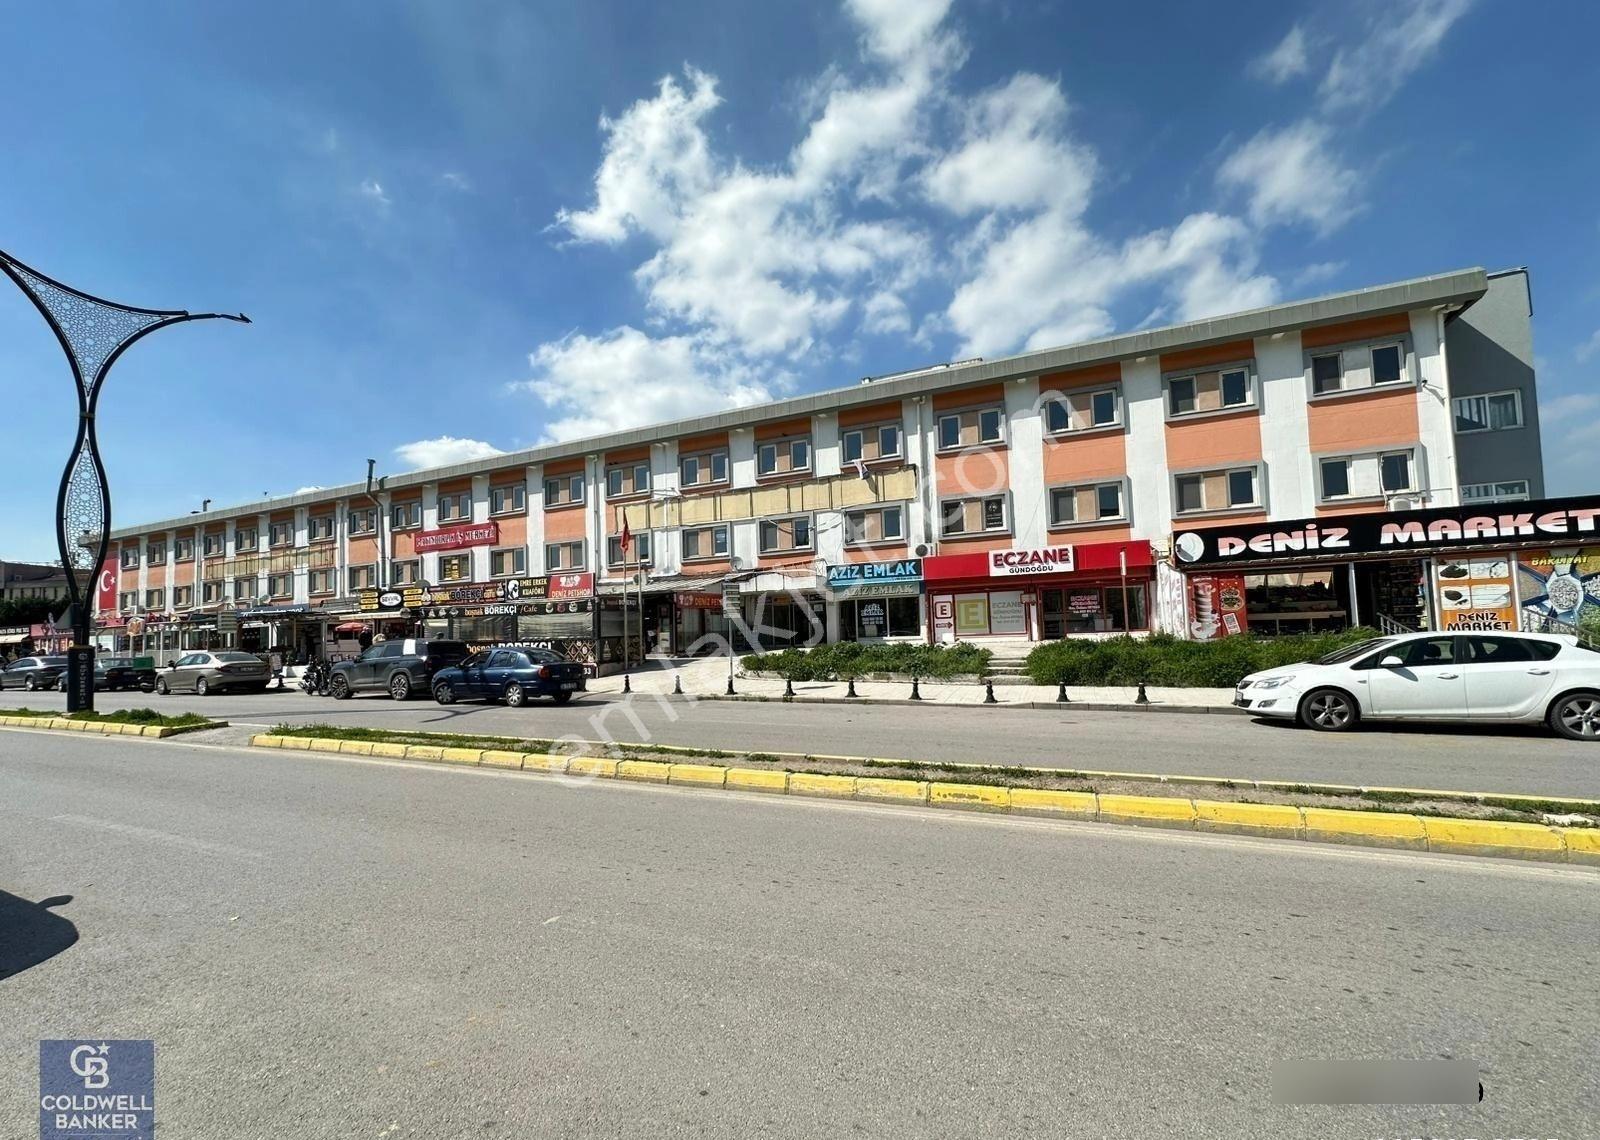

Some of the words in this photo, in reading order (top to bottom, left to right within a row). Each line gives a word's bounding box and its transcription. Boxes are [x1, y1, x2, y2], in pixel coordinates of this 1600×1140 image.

[1380, 508, 1600, 545] MARKET
[993, 547, 1071, 569] ECZANE
[864, 561, 917, 578] EMLAK
[1009, 565, 1054, 574] GÜNDOĞDU
[872, 584, 914, 596] EMLAK
[940, 604, 948, 616] E
[1446, 621, 1512, 632] MARKET
